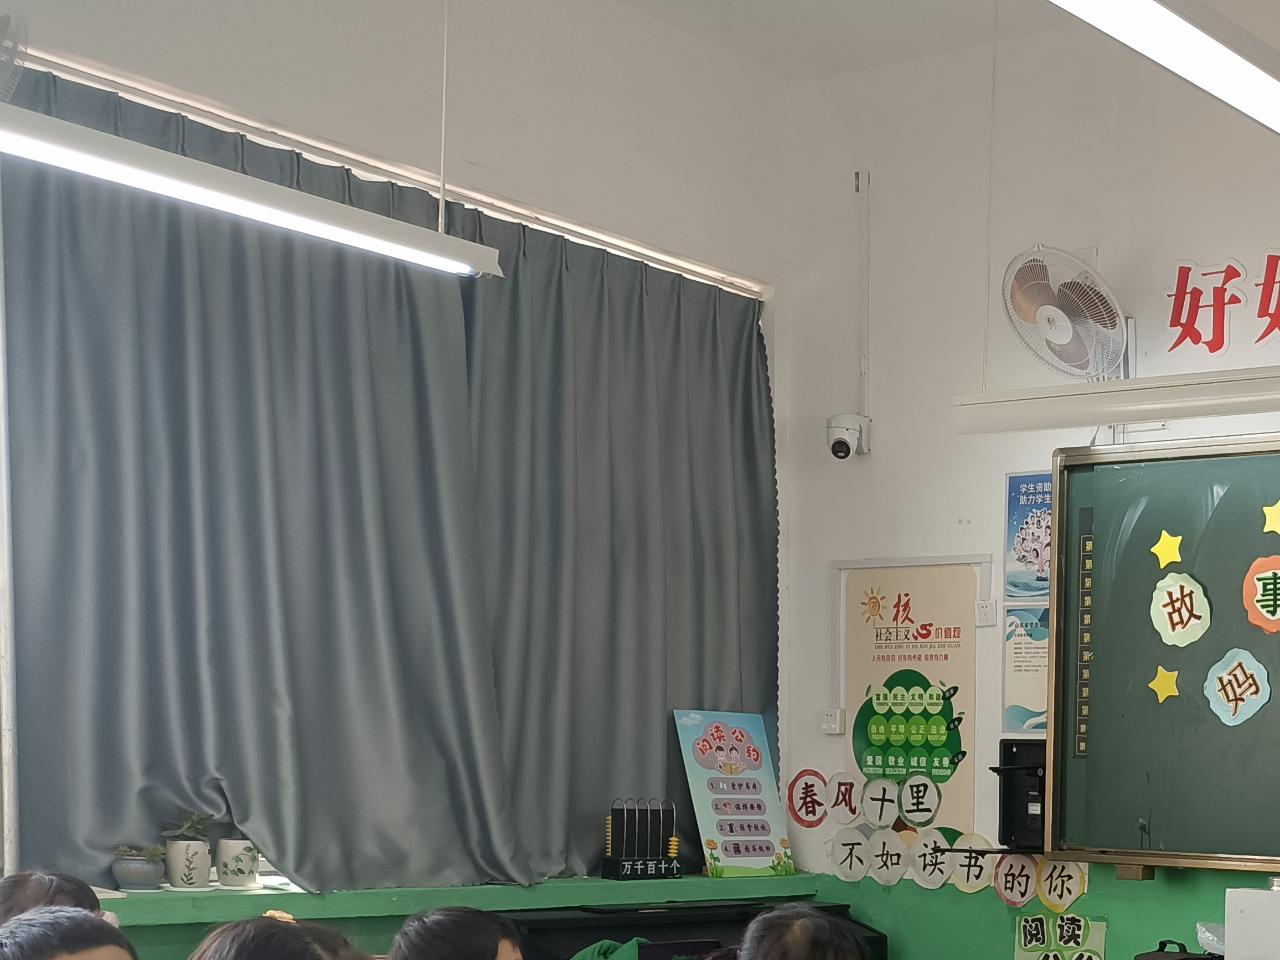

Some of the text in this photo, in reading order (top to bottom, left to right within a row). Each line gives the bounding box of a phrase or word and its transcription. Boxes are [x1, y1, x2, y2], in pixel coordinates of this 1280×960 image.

[875, 627, 910, 642] 社会主义
[935, 626, 961, 639] 价值观
[798, 781, 933, 822] 春风十里
[622, 860, 680, 875] 万千百十个
[839, 840, 1074, 900] 不如读书的你
[1022, 915, 1081, 947] 阅读
